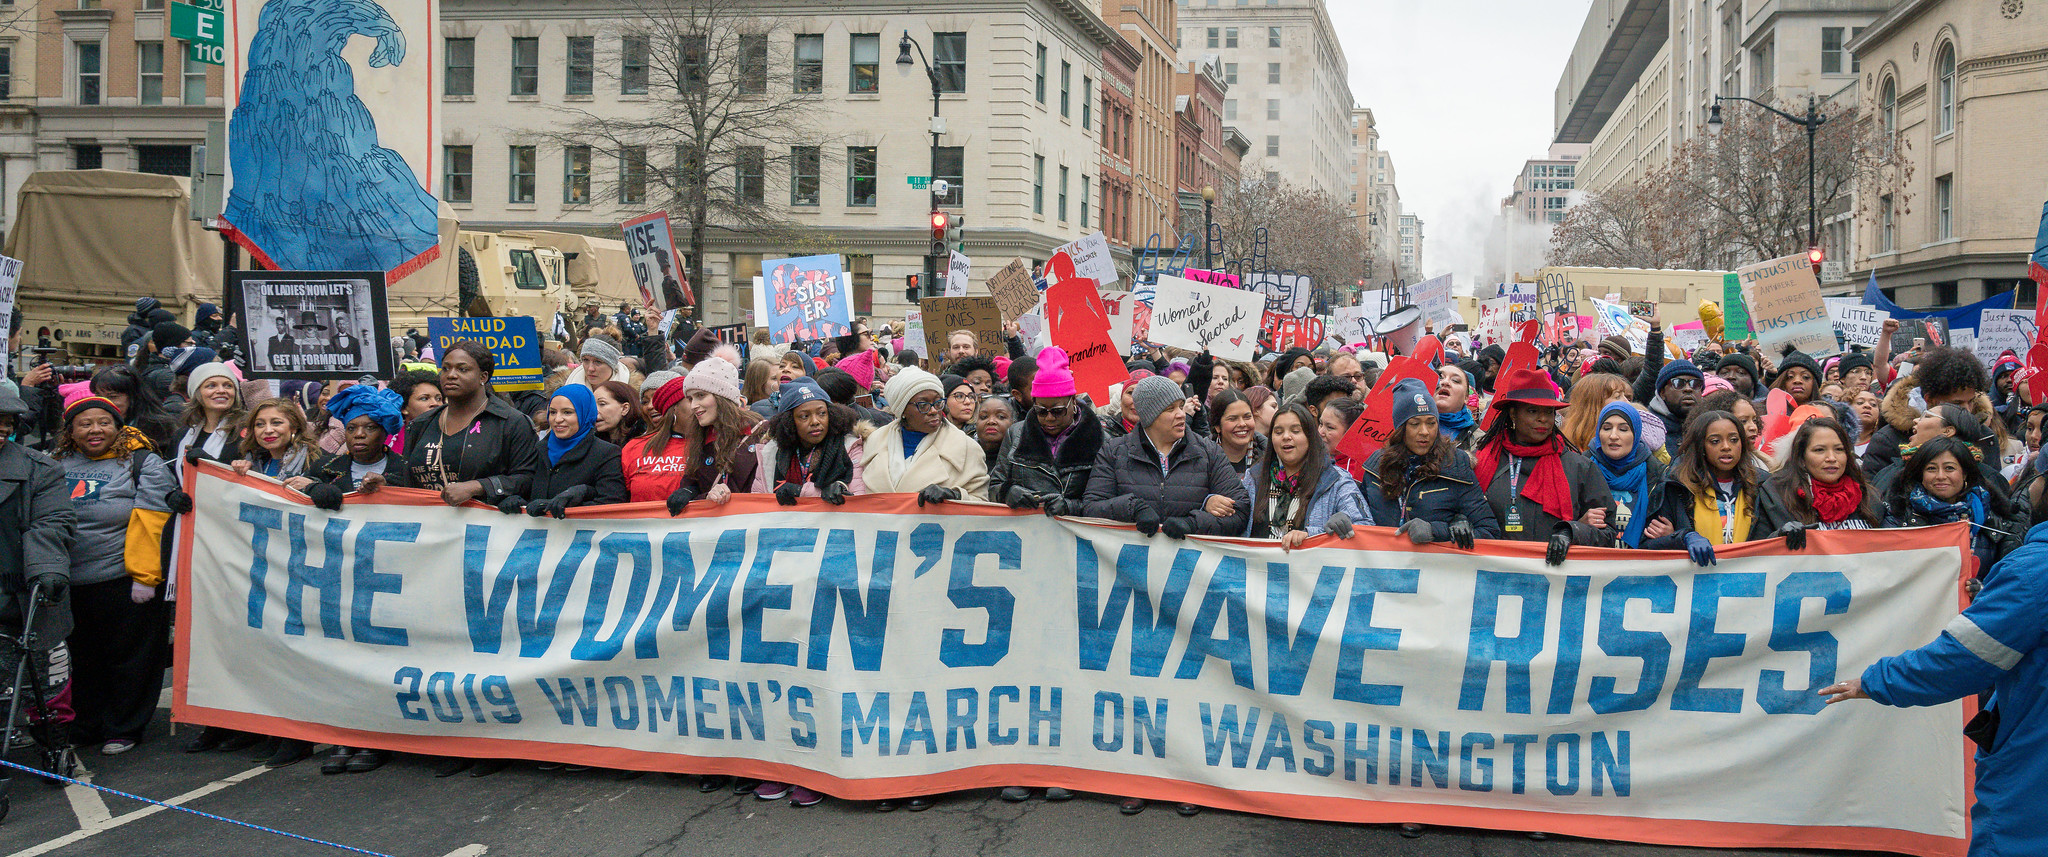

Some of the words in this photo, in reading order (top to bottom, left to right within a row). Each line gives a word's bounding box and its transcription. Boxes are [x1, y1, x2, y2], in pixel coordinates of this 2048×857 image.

[197, 12, 215, 39] E
[625, 223, 659, 259] RISE
[985, 259, 1024, 293] NATIONAL
[1742, 258, 1810, 283] INJUSTICE
[261, 285, 274, 295] OK
[275, 285, 305, 295] LADIES
[307, 285, 328, 295] NOW
[329, 284, 353, 295] LET'S
[922, 300, 941, 312] WE
[947, 298, 969, 311] ARE
[971, 298, 996, 309] THE
[1005, 290, 1040, 321] LOANS
[1155, 295, 1211, 327] Women
[1841, 307, 1877, 322] LITTLE
[1983, 310, 2006, 323] Just
[452, 319, 506, 332] SALUD
[945, 311, 976, 327] ONES
[1188, 310, 1213, 333] are
[1196, 305, 1247, 350] Sacred
[1756, 306, 1825, 334] JUSTICE
[1832, 320, 1857, 332] HANDS
[925, 331, 941, 345] WE
[979, 330, 1003, 345] BEEN
[273, 354, 290, 365] GET
[302, 354, 354, 365] FORMATION
[643, 456, 683, 465] WANT
[239, 501, 421, 647] THE
[463, 523, 1022, 672] WOMEN'S
[1076, 536, 1421, 707] WAVE
[1456, 569, 1853, 717] RISES
[394, 665, 521, 725] 2019
[537, 675, 817, 749] WOMEN'S
[840, 685, 1064, 758] MARCH
[1093, 689, 1169, 758] ON
[1199, 702, 1632, 797] WASHINGTON
